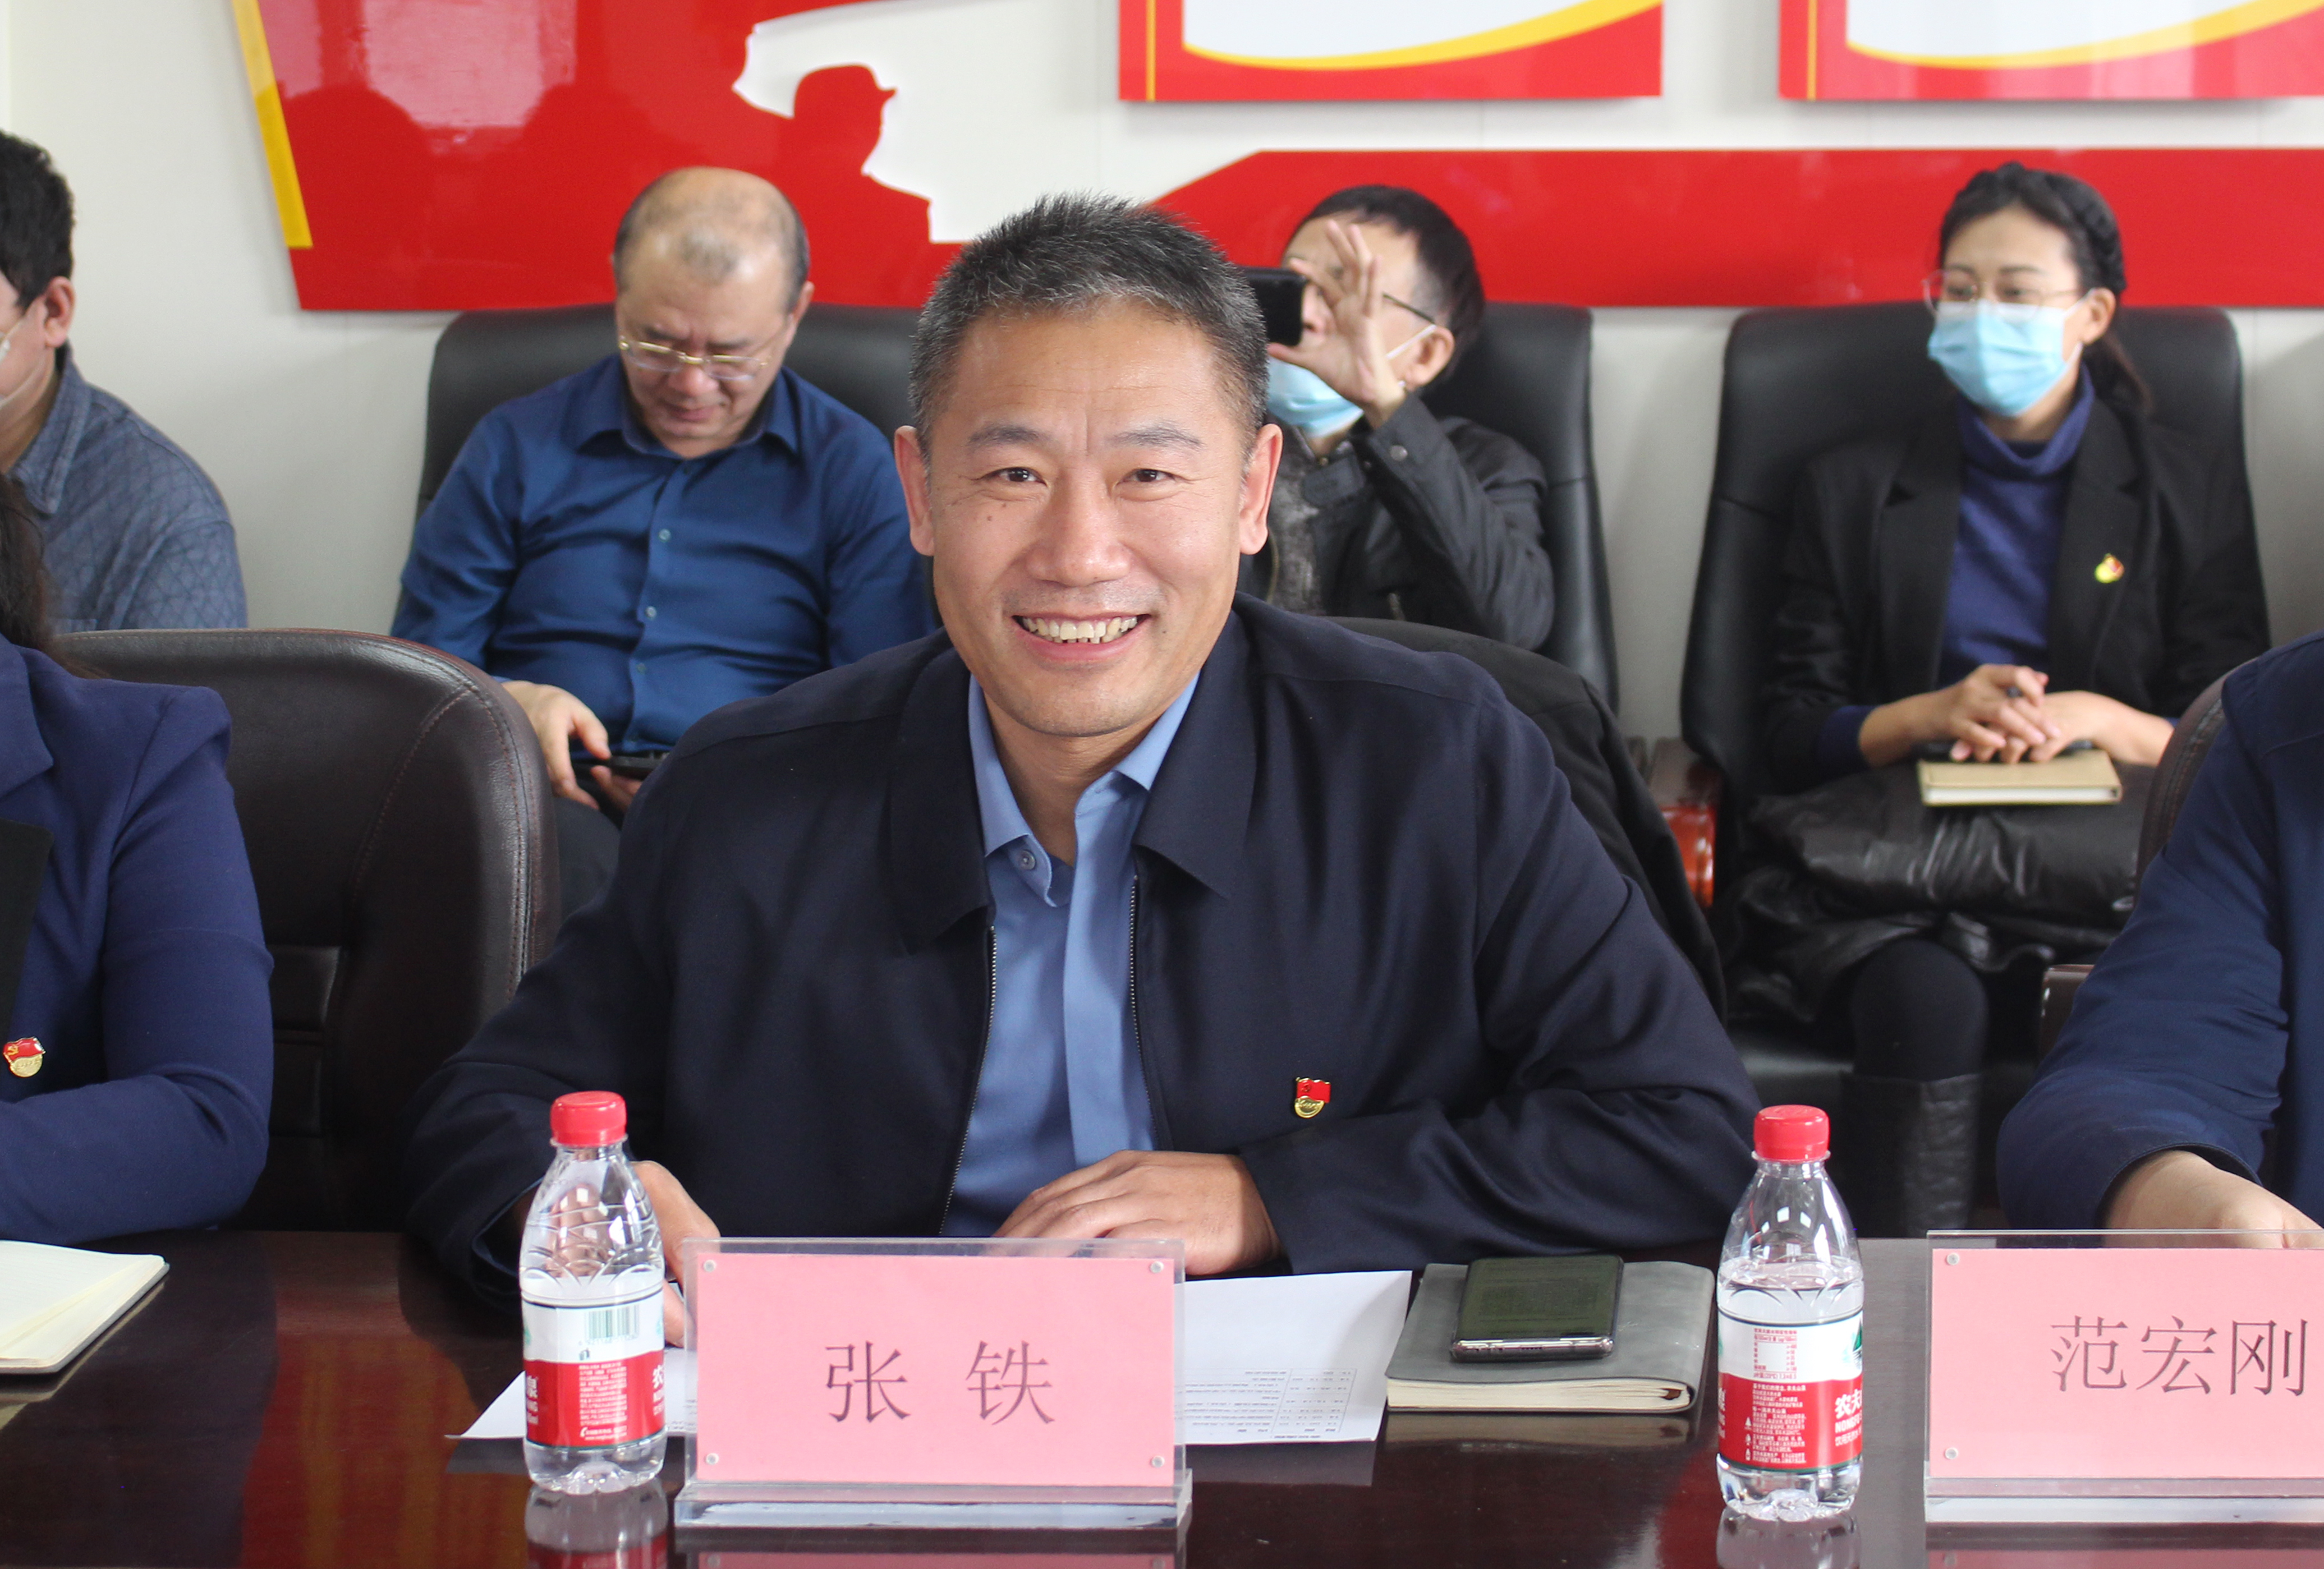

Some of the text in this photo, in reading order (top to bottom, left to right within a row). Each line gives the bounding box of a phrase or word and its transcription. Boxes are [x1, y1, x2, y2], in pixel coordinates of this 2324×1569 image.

[2050, 1315, 2308, 1396] 范宏刚
[1834, 1388, 1862, 1419] 农夫
